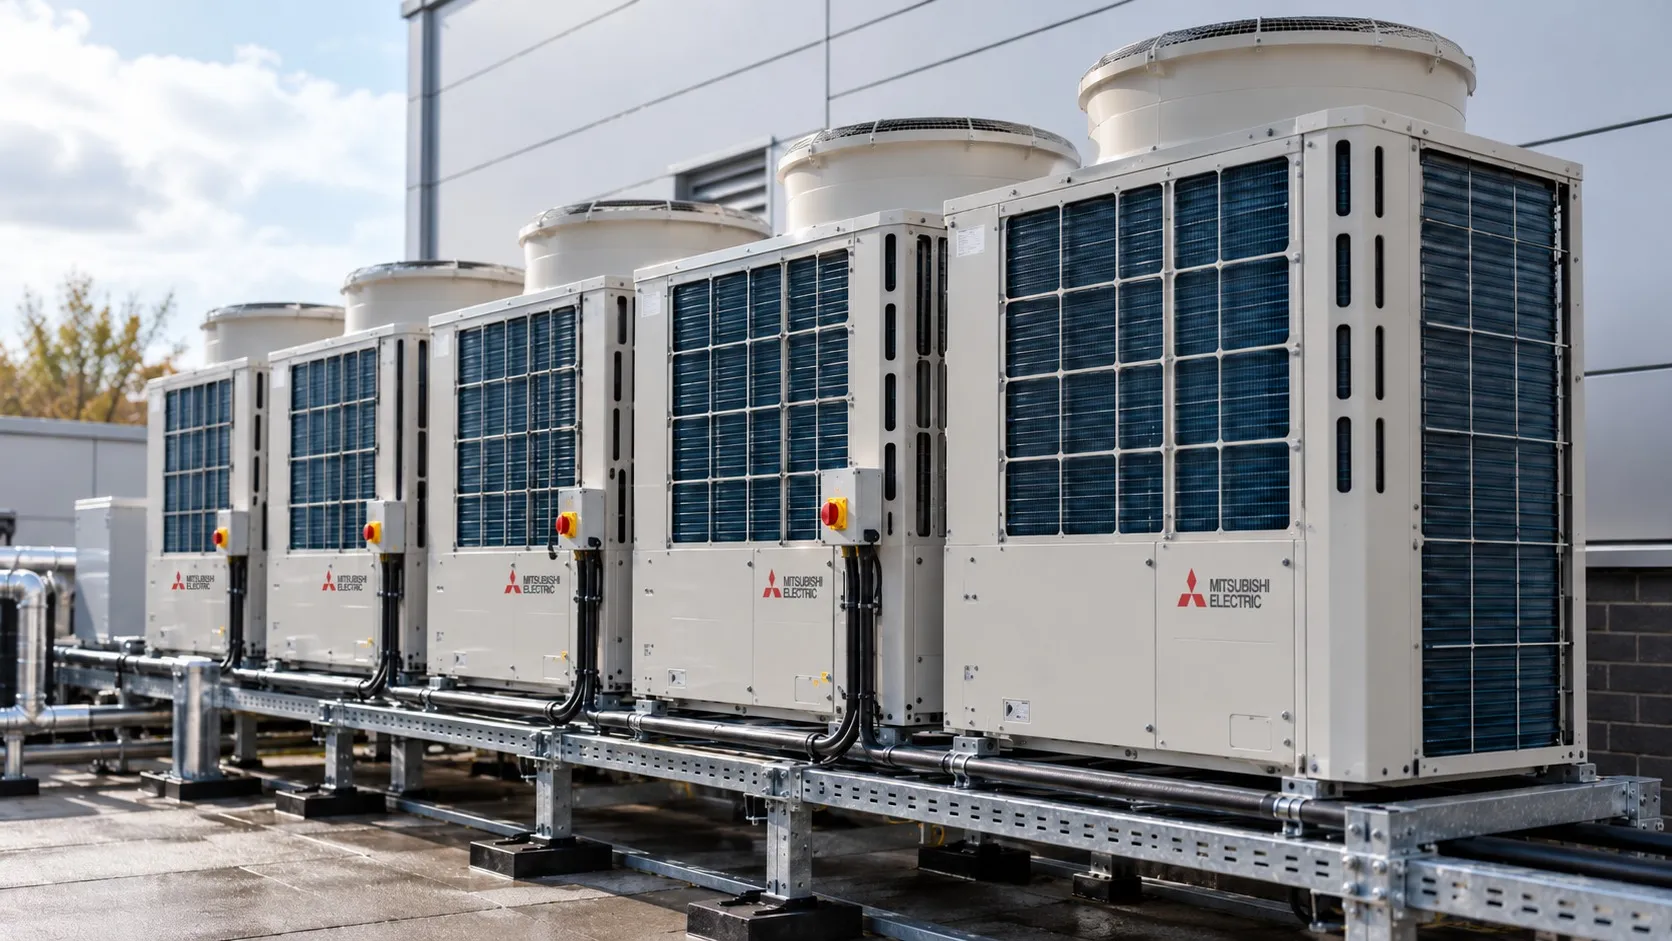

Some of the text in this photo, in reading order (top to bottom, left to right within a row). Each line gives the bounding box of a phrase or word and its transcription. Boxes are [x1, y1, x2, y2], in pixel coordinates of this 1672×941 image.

[783, 576, 823, 587] MITSUBISHI
[1209, 578, 1270, 592] MITSUBISHI
[523, 584, 555, 594] ELECTRIC
[783, 587, 817, 598] ELECTRIC
[1209, 594, 1262, 608] ELECTRIC
